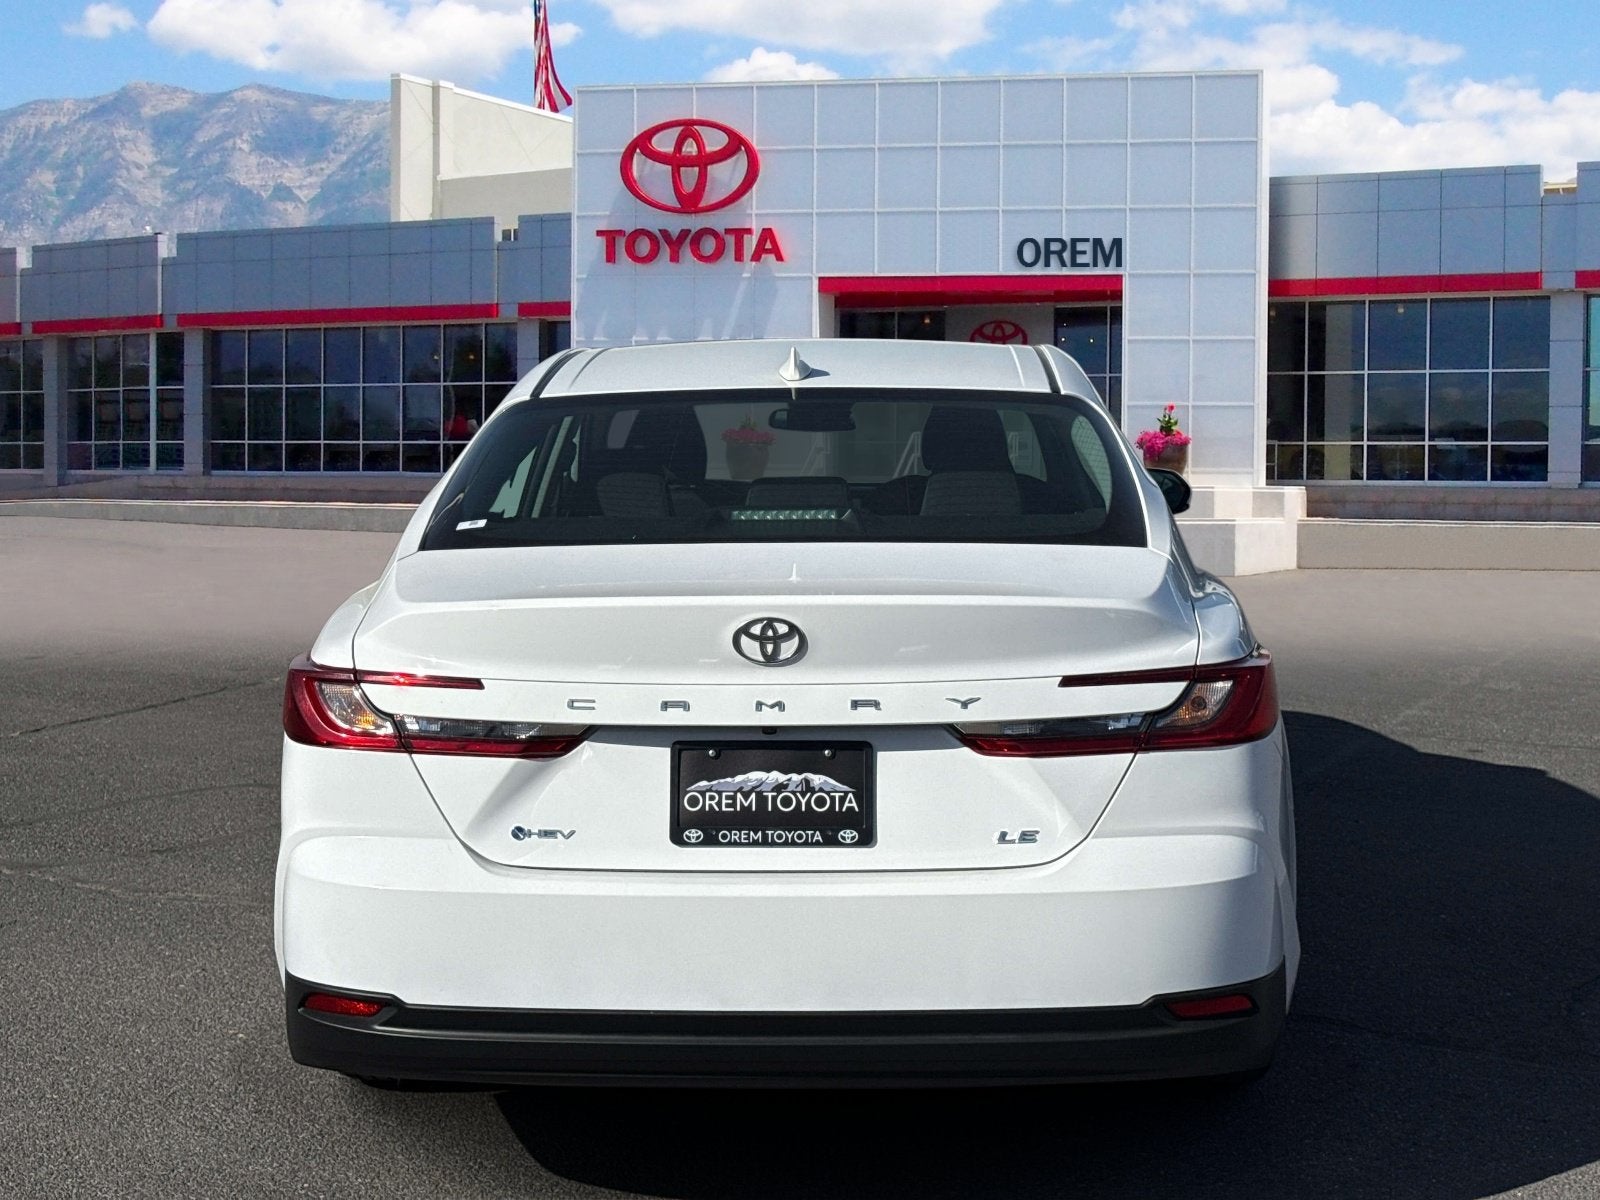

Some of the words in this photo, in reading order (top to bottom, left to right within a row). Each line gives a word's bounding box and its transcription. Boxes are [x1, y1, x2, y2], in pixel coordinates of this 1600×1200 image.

[596, 227, 785, 264] TOYOTA
[1017, 237, 1123, 268] OREM
[566, 696, 982, 712] CAMRY
[683, 791, 756, 812] OREM
[763, 791, 859, 812] TOYOTA
[526, 828, 577, 840] HEV
[718, 830, 762, 843] OREM
[765, 830, 823, 843] TOYOTA
[997, 830, 1040, 844] LE
